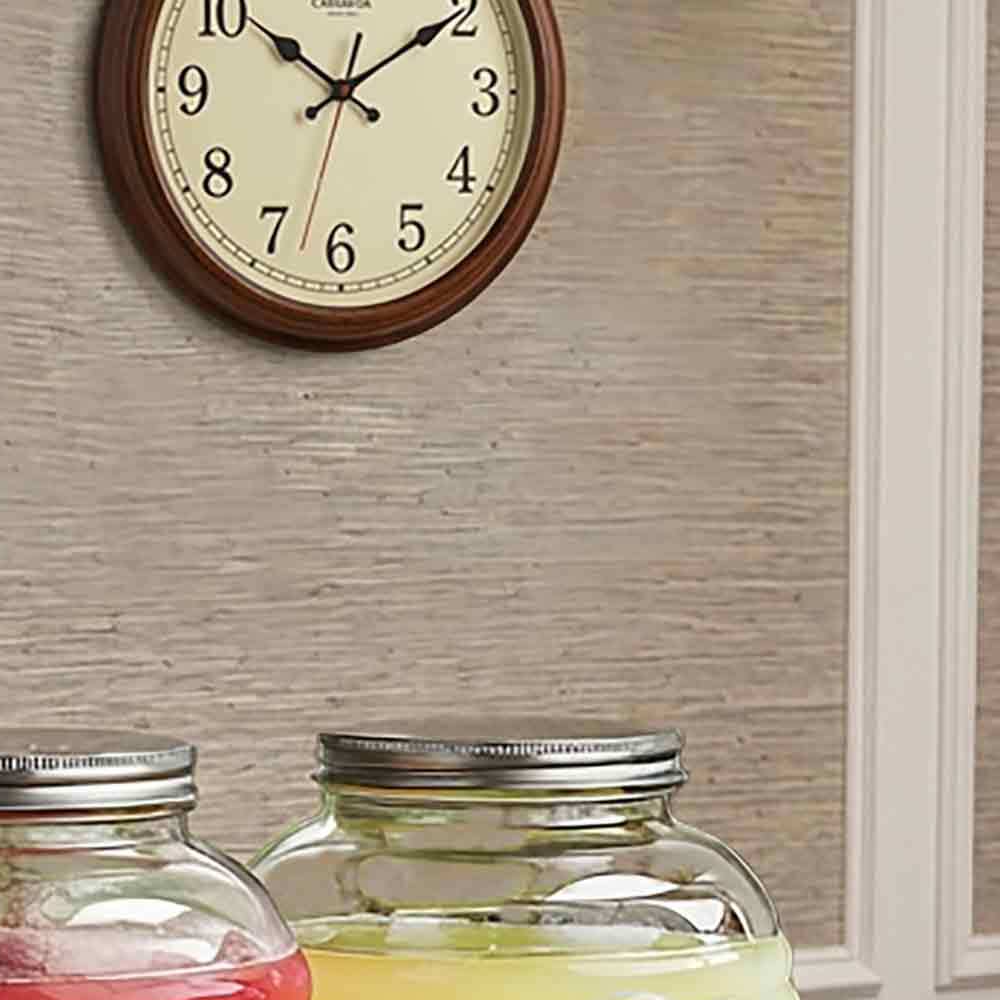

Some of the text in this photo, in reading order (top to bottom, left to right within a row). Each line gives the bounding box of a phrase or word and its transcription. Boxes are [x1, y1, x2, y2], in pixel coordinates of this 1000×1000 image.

[198, 0, 247, 38] 10
[450, 0, 478, 37] 2
[177, 64, 209, 116] 9
[471, 67, 500, 117] 3
[202, 146, 234, 199] 8
[446, 145, 477, 194] 4
[259, 205, 289, 255] 7
[325, 222, 356, 274] 6
[397, 203, 426, 253] 5
